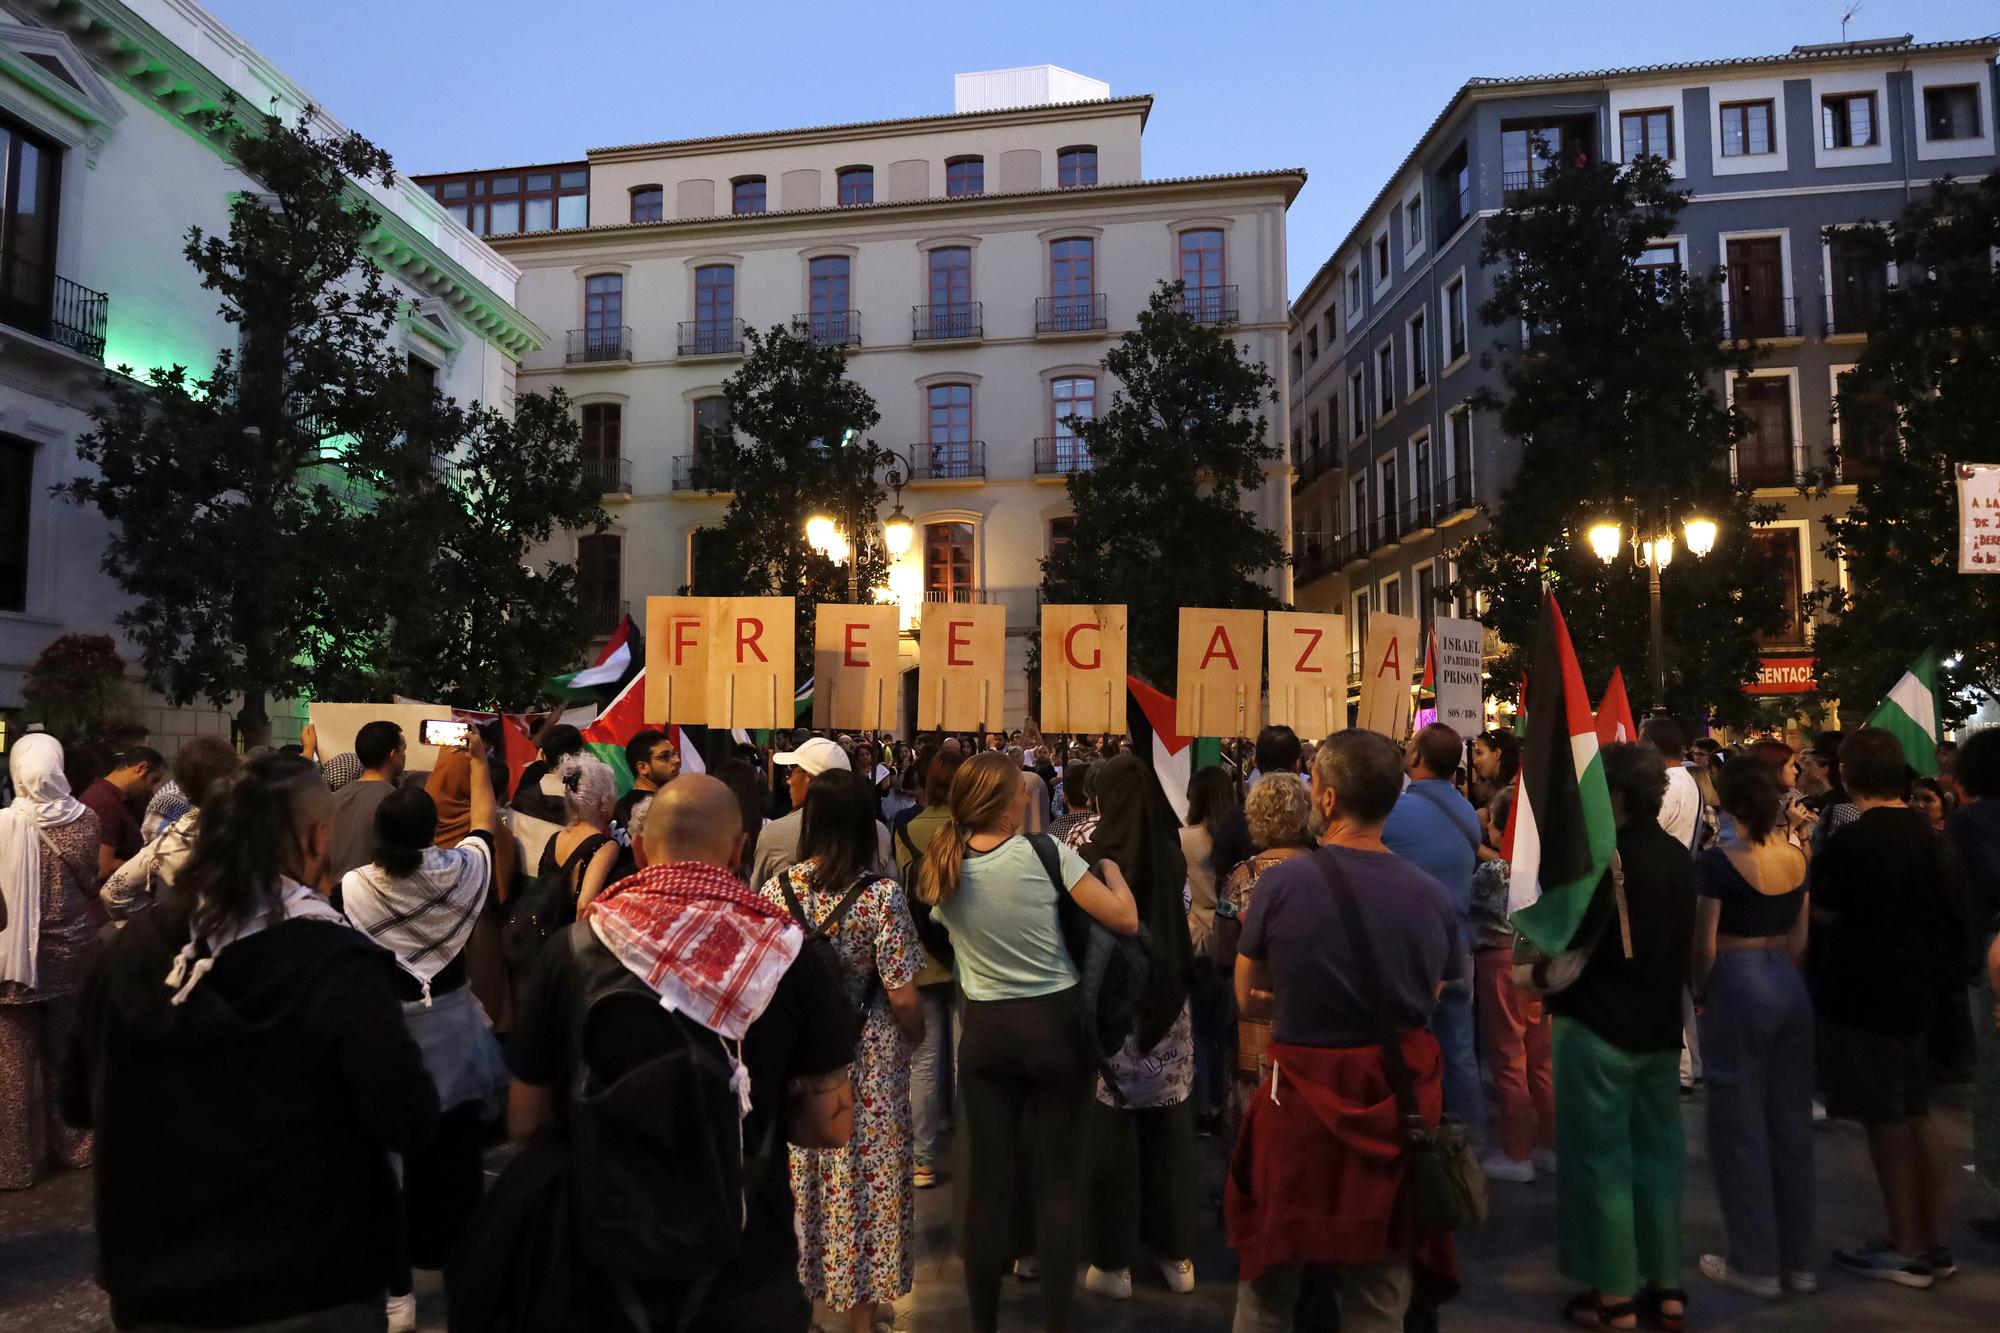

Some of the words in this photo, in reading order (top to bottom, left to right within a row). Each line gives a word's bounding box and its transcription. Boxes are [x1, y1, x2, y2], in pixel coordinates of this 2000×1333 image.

[1971, 497, 1980, 508] A
[1973, 518, 1989, 528] DE
[674, 617, 974, 667] FREE
[1063, 623, 1401, 681] GAZA
[1443, 636, 1480, 654] ISRAEL
[1443, 669, 1479, 686] PRISON
